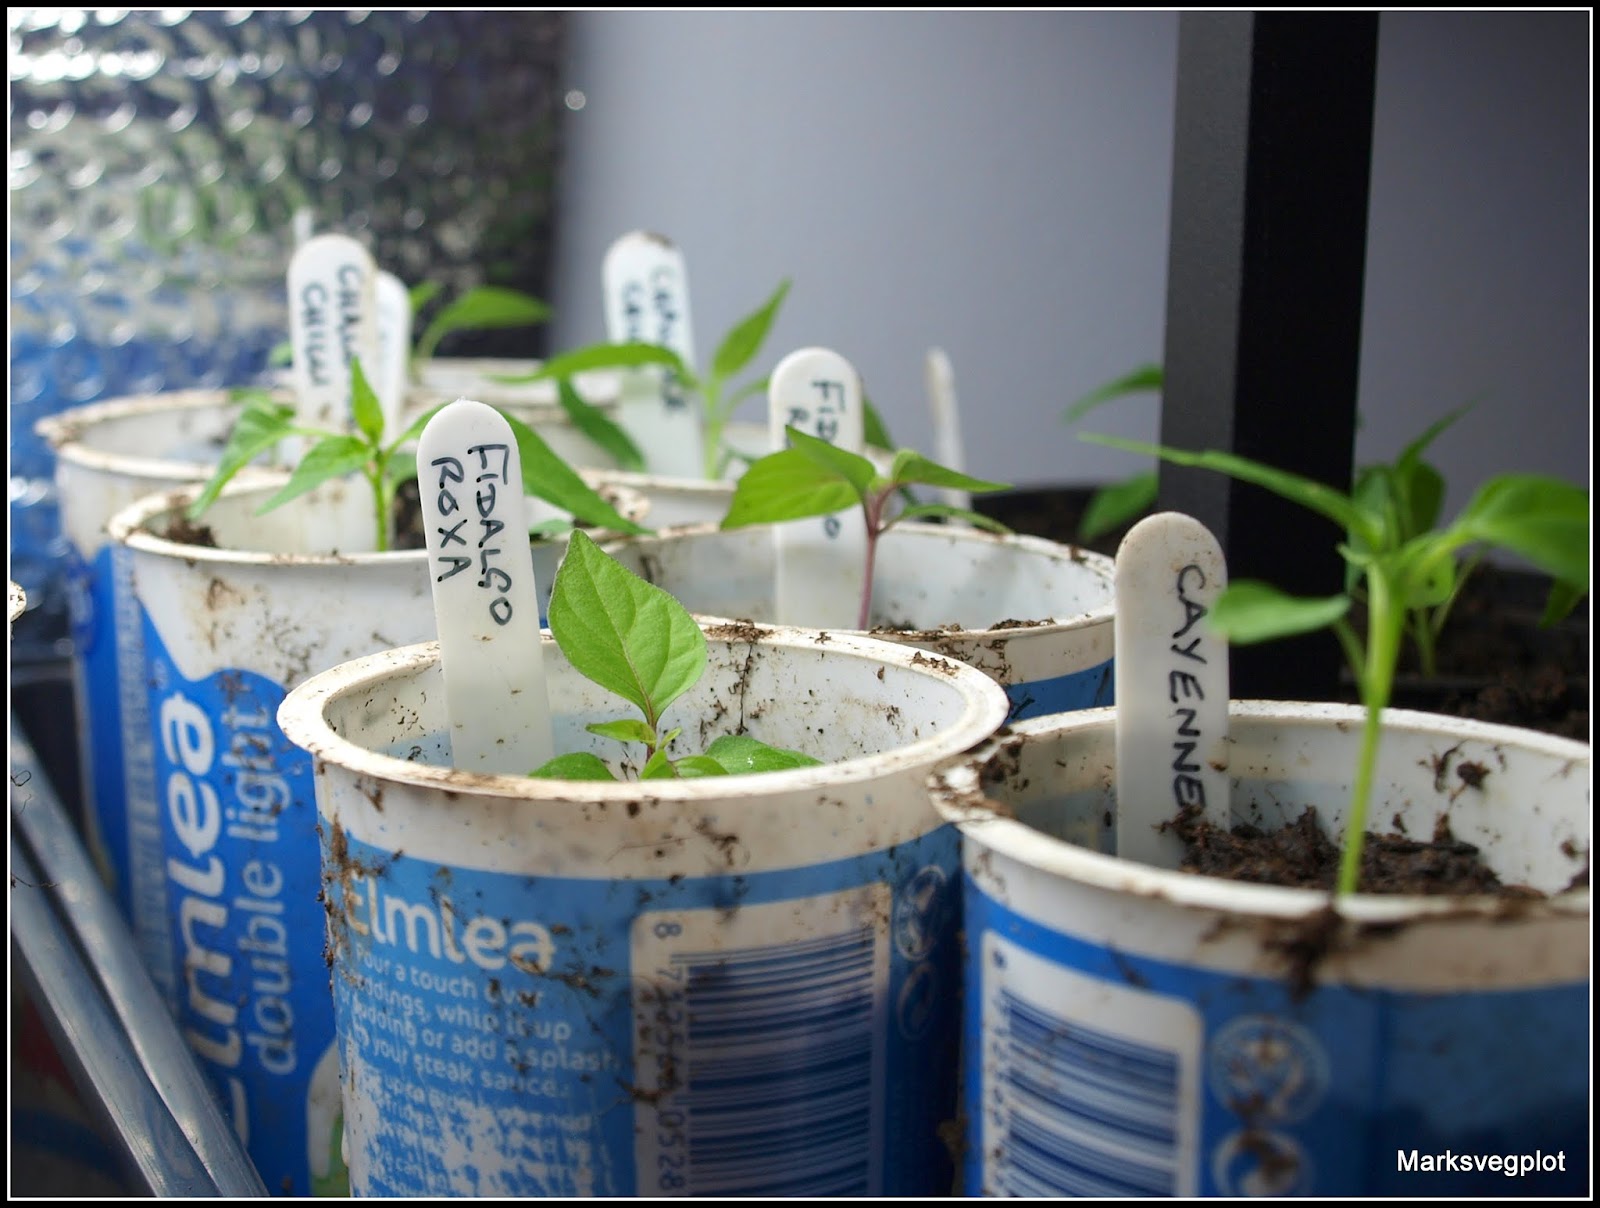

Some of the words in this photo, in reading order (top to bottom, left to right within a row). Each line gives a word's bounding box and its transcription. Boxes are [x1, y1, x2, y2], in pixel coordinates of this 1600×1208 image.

[431, 456, 472, 583] ROXA
[467, 443, 513, 626] FIDALGO
[1169, 564, 1208, 808] CAYENNE
[220, 703, 291, 842] light
[233, 859, 298, 1075] double
[653, 921, 684, 938] 8
[394, 962, 407, 982] a
[411, 963, 478, 1000] touch
[435, 1002, 500, 1034] whip
[533, 1018, 573, 1042] up
[412, 1053, 475, 1086] steak
[422, 1027, 446, 1050] or
[451, 1033, 498, 1062] add
